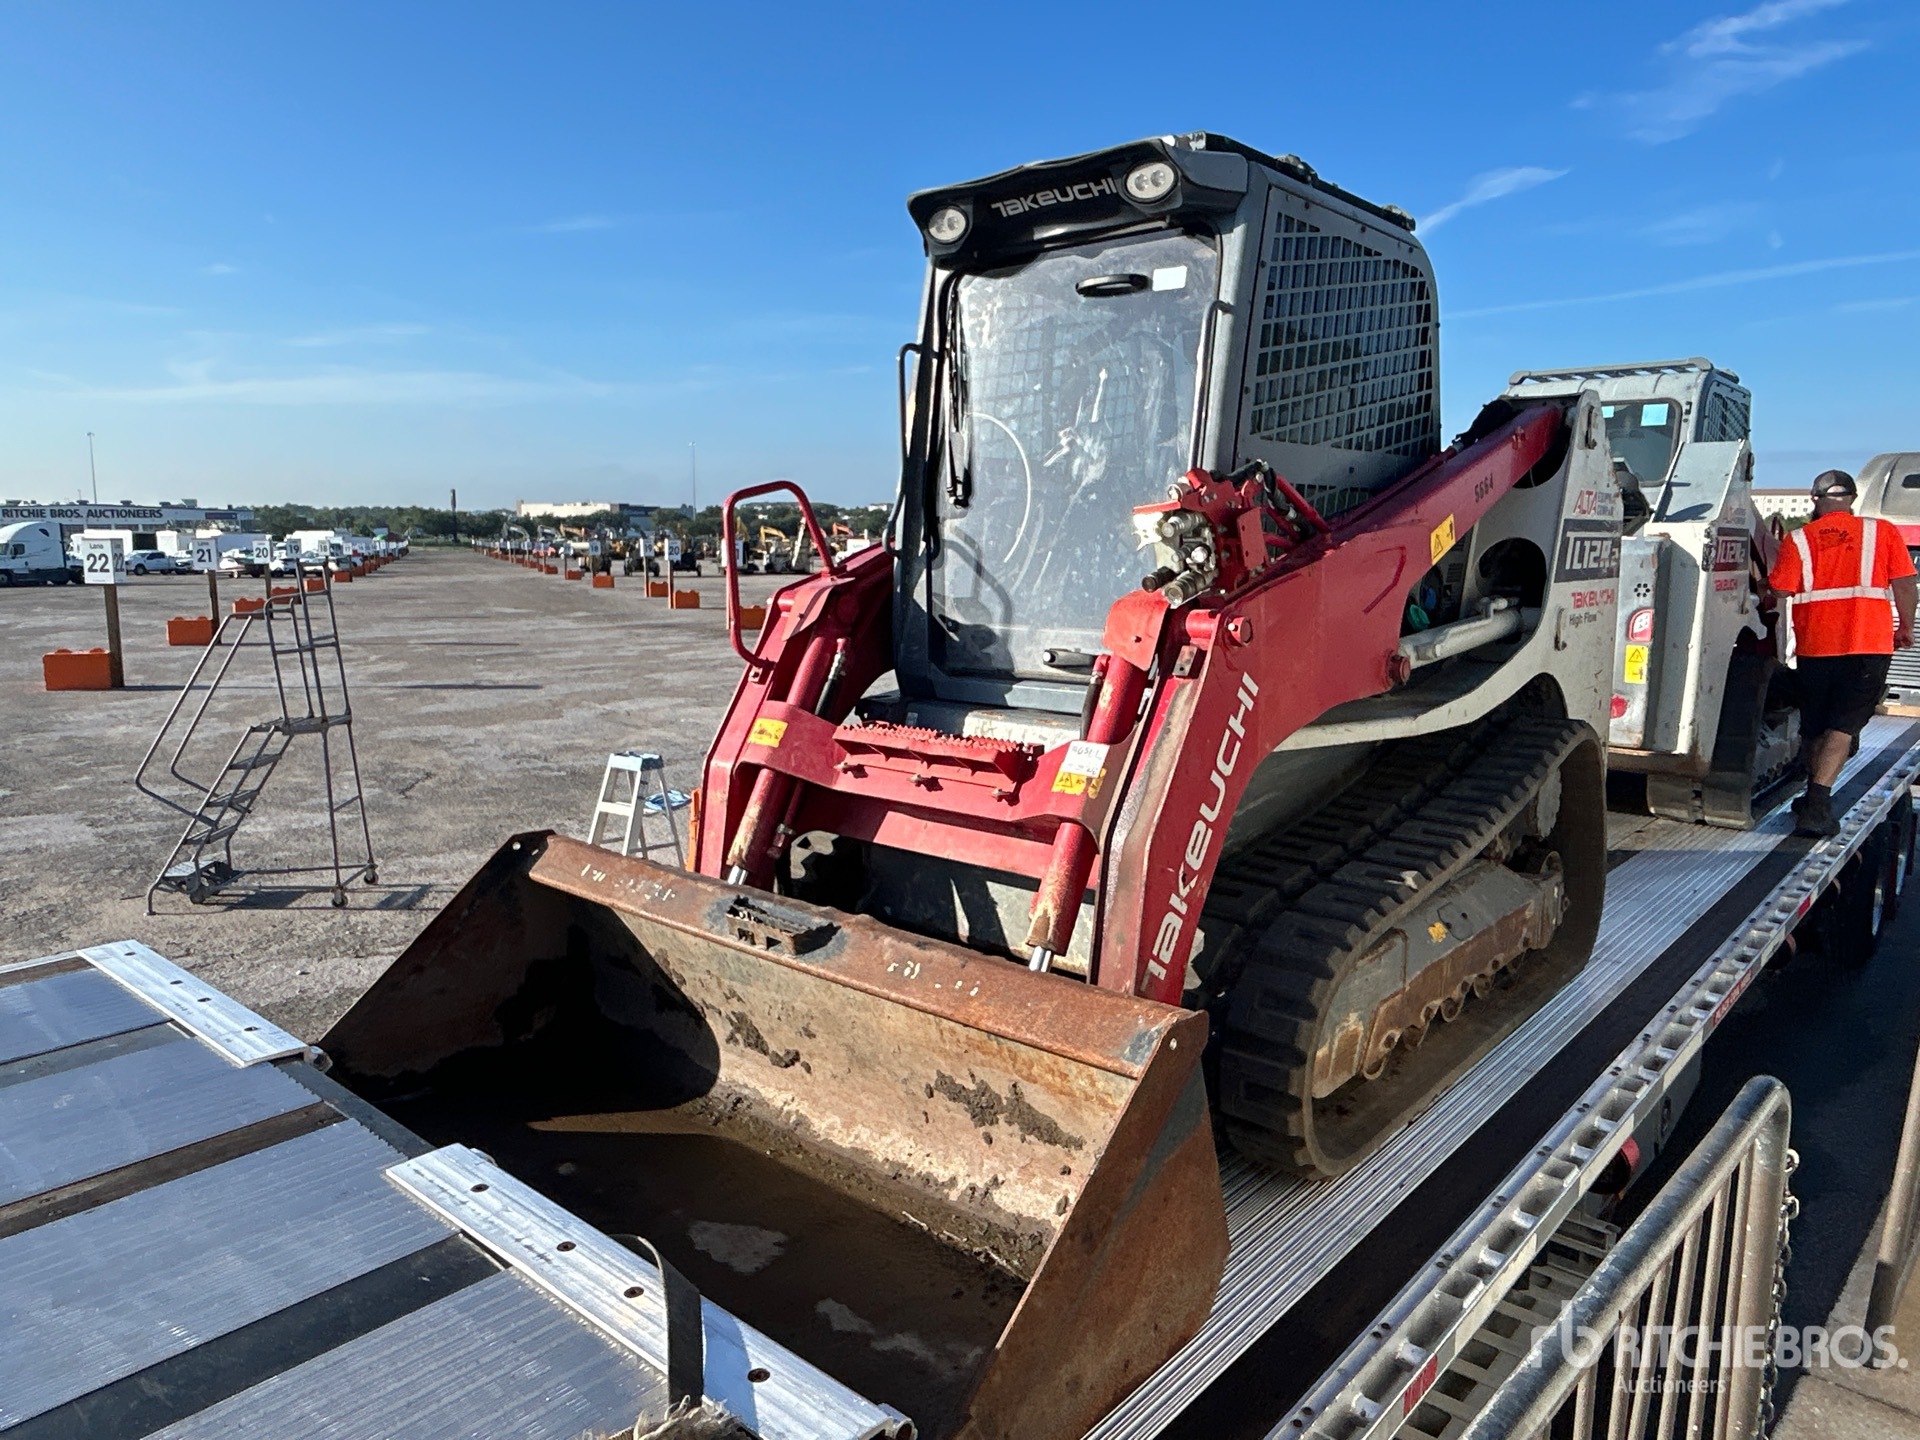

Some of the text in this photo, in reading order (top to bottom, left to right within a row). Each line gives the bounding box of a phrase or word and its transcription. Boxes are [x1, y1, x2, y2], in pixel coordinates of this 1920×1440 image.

[2, 508, 163, 519] RITCHIE BROS. AUCTIONEERS
[196, 548, 213, 563] 21
[255, 546, 269, 558] 20
[289, 545, 300, 554] 19
[669, 546, 680, 556] 20
[86, 552, 111, 573] 22
[1139, 671, 1259, 993] TAKEUCHI
